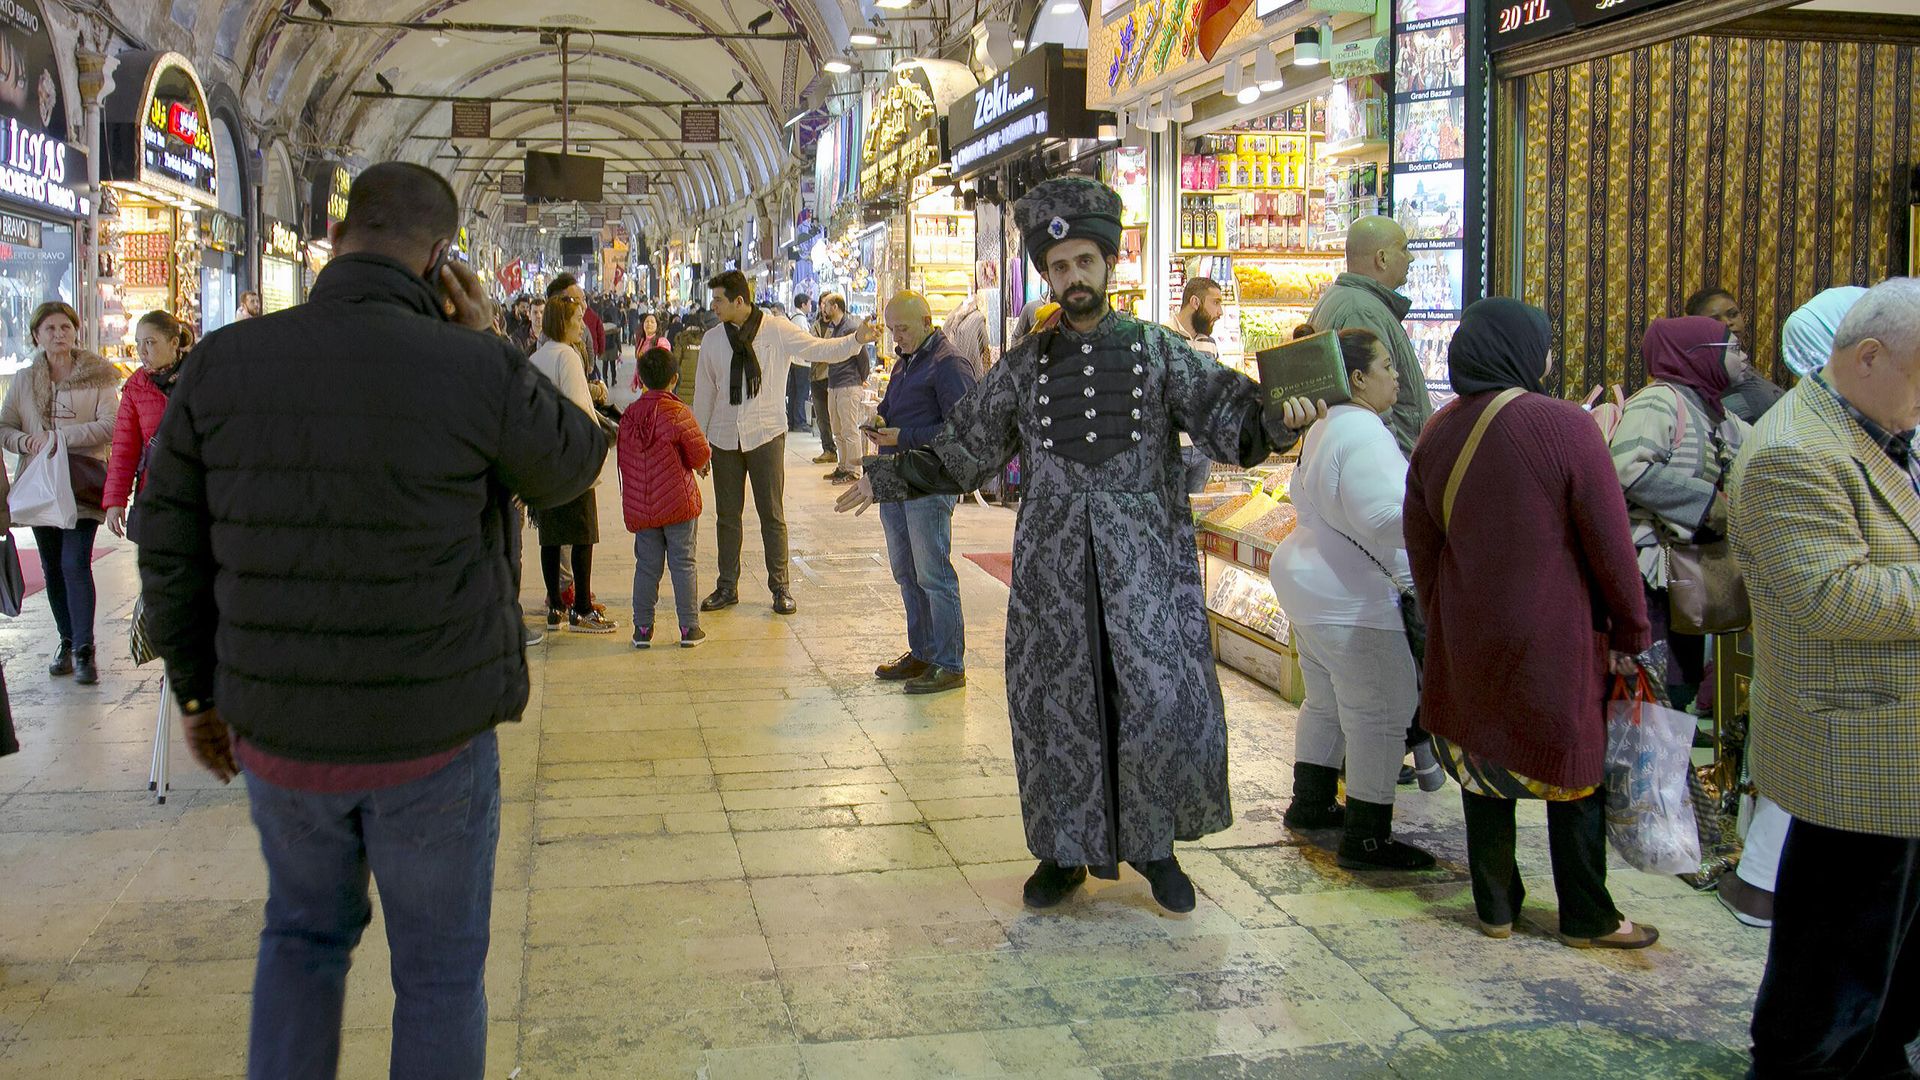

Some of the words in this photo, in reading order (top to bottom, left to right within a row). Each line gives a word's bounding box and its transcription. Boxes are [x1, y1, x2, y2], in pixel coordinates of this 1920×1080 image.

[15, 4, 39, 32] BRAVO
[1431, 17, 1458, 28] Museum
[1498, 5, 1521, 34] 20
[1523, 0, 1550, 25] TL
[1410, 89, 1430, 100] Grand
[1430, 90, 1453, 99] Bazaar
[973, 71, 1010, 130] Zeki
[1408, 163, 1433, 172] Bodrum
[1432, 161, 1453, 169] Castle
[2, 215, 28, 240] BRAVO
[1428, 240, 1456, 248] Museum
[1427, 311, 1454, 319] Museum
